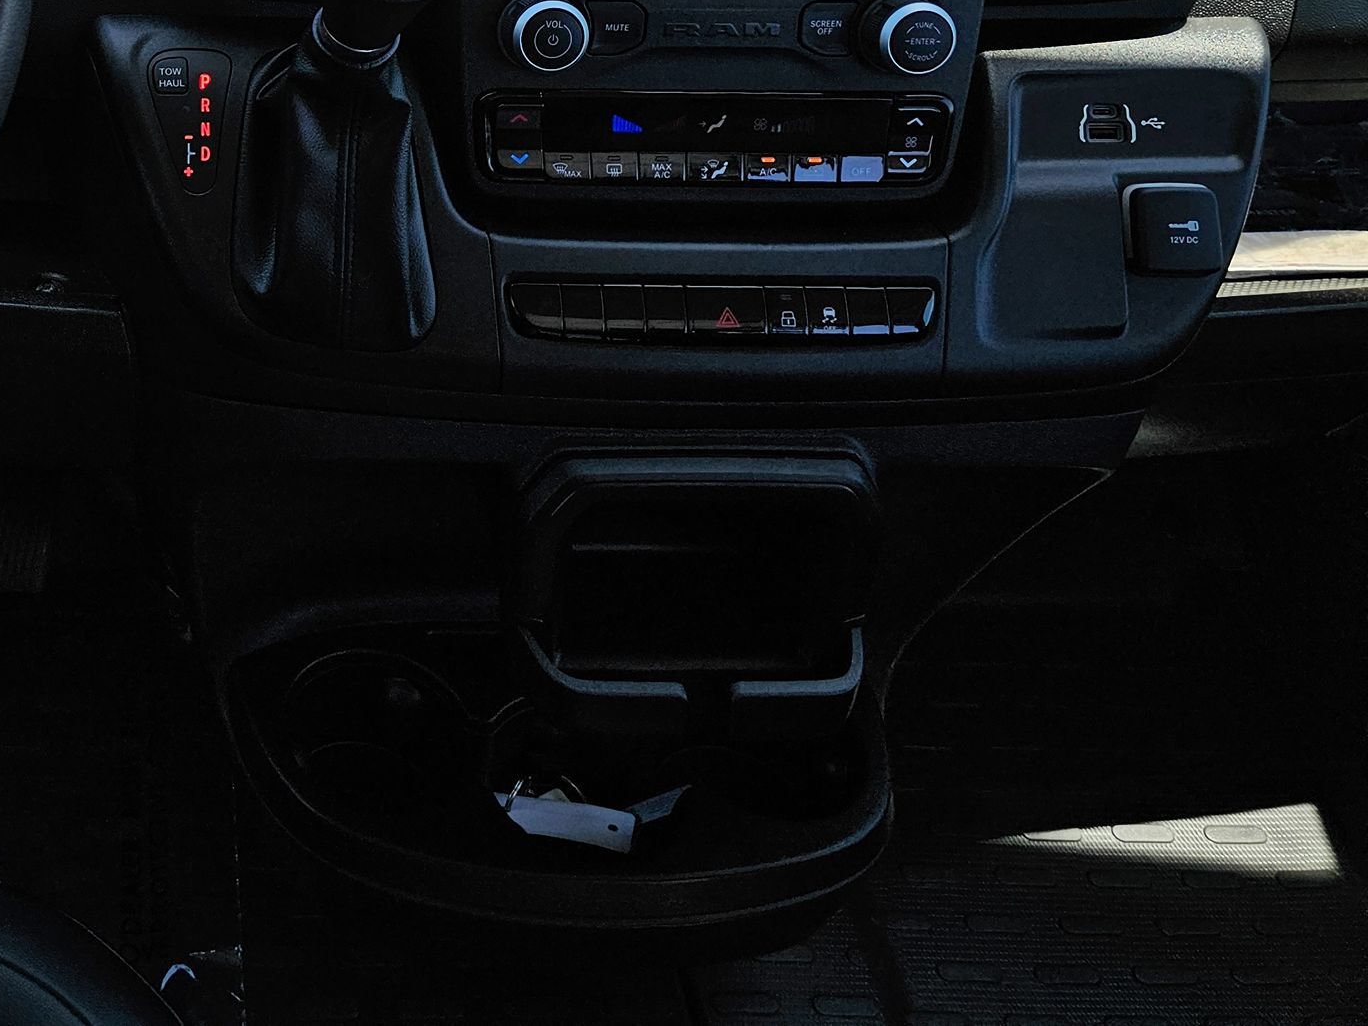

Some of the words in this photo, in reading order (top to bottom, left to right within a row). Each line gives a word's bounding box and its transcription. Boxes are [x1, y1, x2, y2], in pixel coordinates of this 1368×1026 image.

[546, 20, 563, 29] VOL
[605, 24, 630, 32] MUTE
[810, 20, 842, 28] SCREEN
[664, 22, 781, 37] RAM
[817, 28, 833, 36] OFF
[908, 52, 935, 61] SCROLL
[159, 68, 182, 76] TOW
[159, 79, 186, 87] HAUL
[199, 74, 211, 90] P
[200, 98, 211, 113] R
[200, 121, 211, 137] N
[200, 146, 211, 162] D
[651, 163, 672, 171] MAX
[759, 167, 777, 176] A/C
[851, 167, 872, 176] OFF
[654, 171, 671, 179] A/C
[1169, 236, 1185, 244] 12V
[1186, 236, 1199, 244] DC
